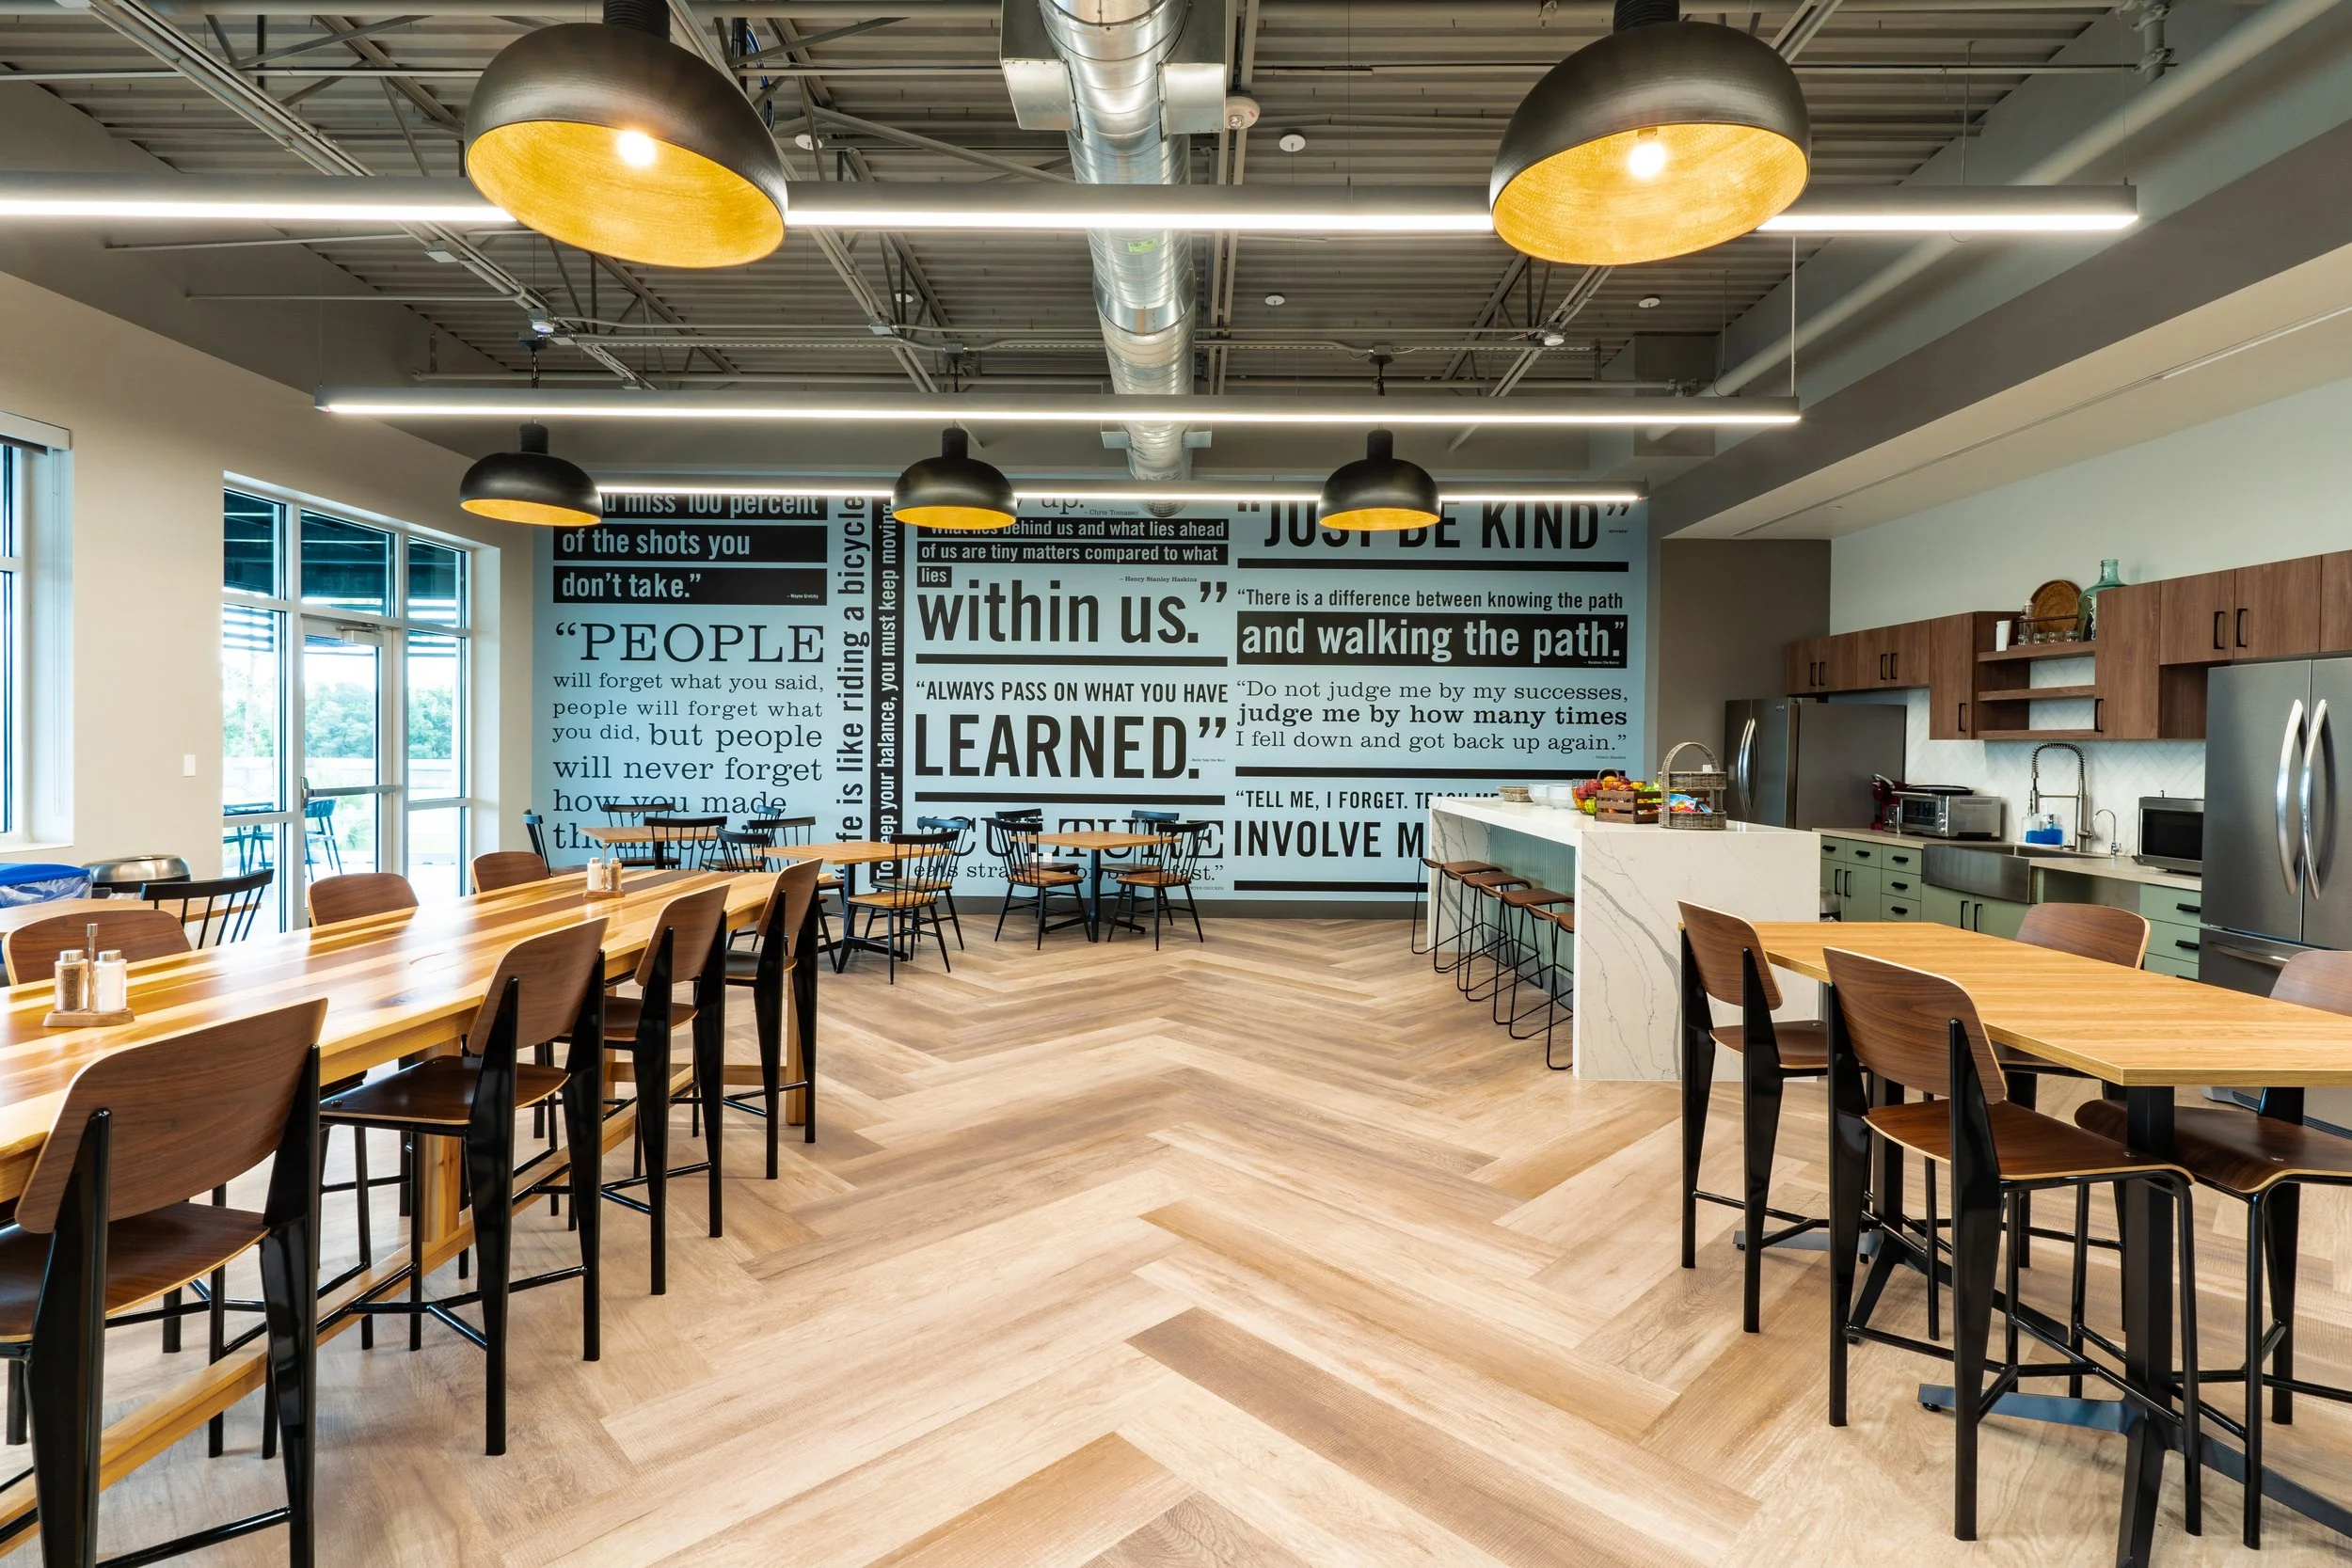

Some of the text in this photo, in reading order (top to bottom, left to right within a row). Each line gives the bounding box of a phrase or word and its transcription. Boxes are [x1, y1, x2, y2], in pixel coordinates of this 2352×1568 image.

[625, 493, 675, 513] miss
[730, 495, 818, 518] percent
[1003, 520, 1052, 535] behind
[1057, 524, 1073, 535] us
[1078, 521, 1104, 535] and
[1110, 521, 1145, 535] what
[1151, 521, 1174, 536] lies
[1180, 522, 1224, 536] ahead
[1482, 501, 1630, 549] KIND”
[563, 528, 749, 560] of the shots you
[837, 496, 871, 594] bicycle
[922, 544, 1217, 562] of us are tiny matters compared to what
[563, 573, 700, 597] don’t take.”
[922, 568, 946, 582] lies
[879, 570, 898, 610] keep
[1238, 589, 1622, 611] “There is a difference between knowing the path
[844, 607, 864, 621] a
[917, 579, 1227, 644] within us.”
[556, 622, 823, 662] “PEOPLE
[880, 616, 895, 656] must
[1243, 619, 1625, 663] and walking the path.”
[553, 673, 823, 693] will forget what you said,
[837, 631, 869, 711] riding
[882, 662, 898, 690] you
[916, 681, 1228, 703] “ALWAYS PASS ON WHAT YOU HAVE
[1237, 681, 1627, 703] “Do not judge me by my successes,
[553, 700, 822, 720] people will forget what
[1237, 704, 1627, 729] judge me by how many times
[552, 723, 821, 752] you did, but people
[877, 697, 897, 767] balance,
[1236, 731, 1626, 753] I fell down and got back up again.”
[836, 723, 863, 771] like
[915, 714, 1226, 779] LEARNED.”
[553, 756, 821, 786] will never forget
[553, 789, 620, 812] how
[701, 792, 787, 814] made
[836, 784, 863, 803] is
[881, 773, 898, 810] your
[1236, 791, 1283, 807] “TELL
[1291, 791, 1319, 811] ME,
[1327, 791, 1332, 809] I
[1340, 792, 1407, 809] FORGET.
[1235, 821, 1381, 857] INVOLVE
[876, 861, 894, 879] To
